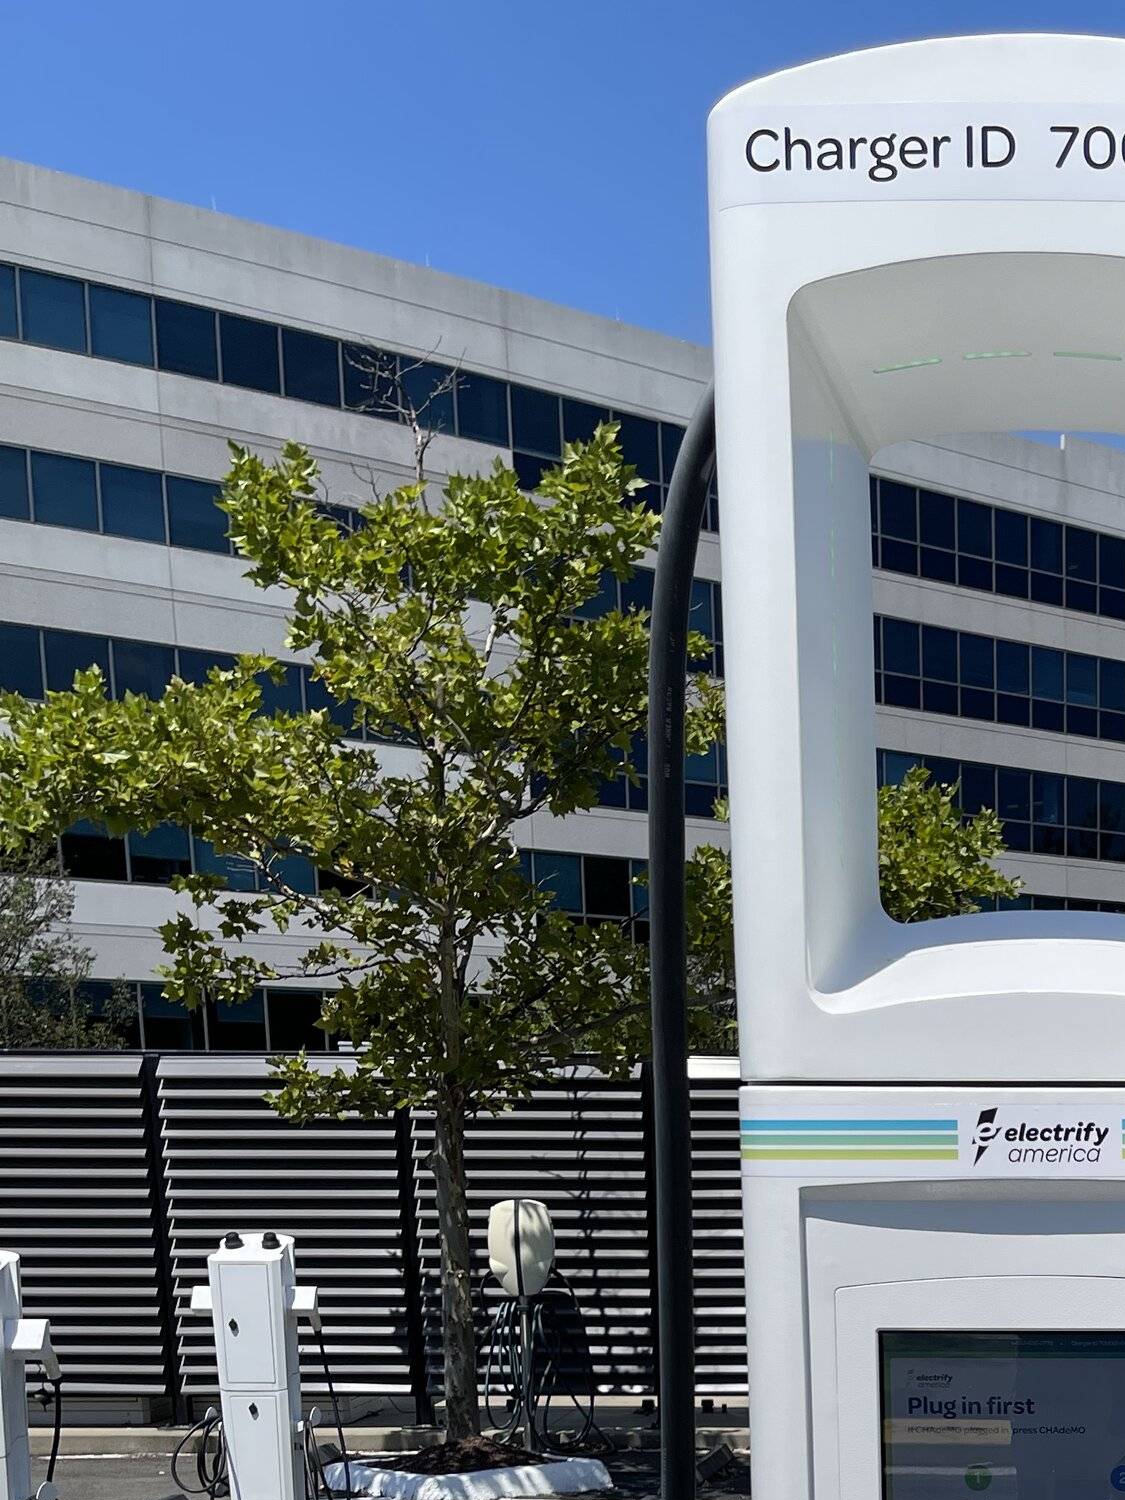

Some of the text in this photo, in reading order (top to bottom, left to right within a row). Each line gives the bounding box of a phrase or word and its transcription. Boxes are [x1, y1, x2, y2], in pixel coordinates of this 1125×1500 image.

[745, 126, 952, 182] Charger
[966, 125, 1016, 169] ID
[1005, 1122, 1109, 1146] electrify
[1008, 1145, 1101, 1163] america
[916, 1374, 953, 1384] electrify
[907, 1396, 1036, 1419] Plug in first
[1012, 1428, 1037, 1436] press
